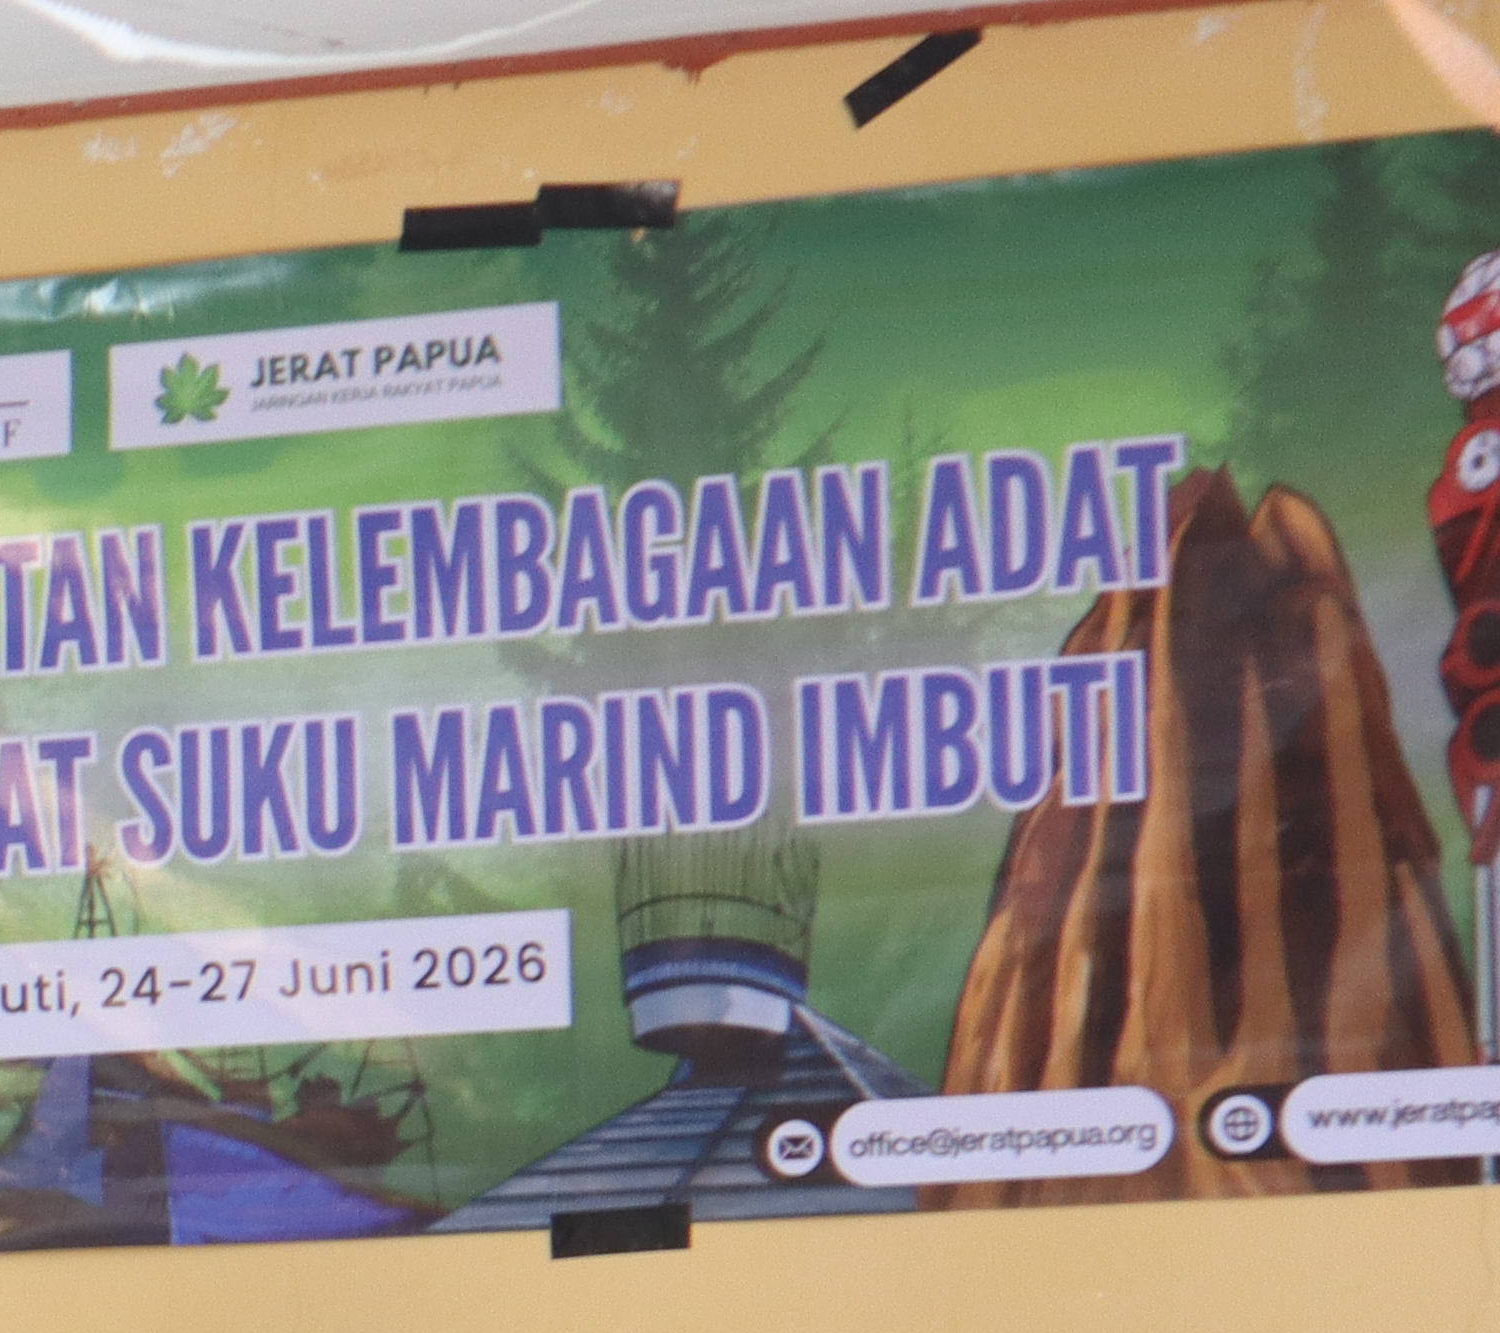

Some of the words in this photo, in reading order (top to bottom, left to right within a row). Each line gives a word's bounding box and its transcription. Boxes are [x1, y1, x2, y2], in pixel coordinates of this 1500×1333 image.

[250, 347, 362, 388] JERAT
[373, 333, 503, 376] PAPUA
[187, 461, 888, 664] KELEMBAGAAN
[916, 434, 1185, 607] ADAT
[117, 714, 363, 868] SUKU
[390, 683, 770, 853] MARIND
[795, 651, 1147, 825] IMBUTI
[99, 960, 257, 1009] 24-27
[278, 948, 392, 1000] Juni
[412, 941, 548, 991] 2026
[850, 1121, 1158, 1158] office@jeratpapua.org
[1308, 1098, 1500, 1130] www.jeratpa
